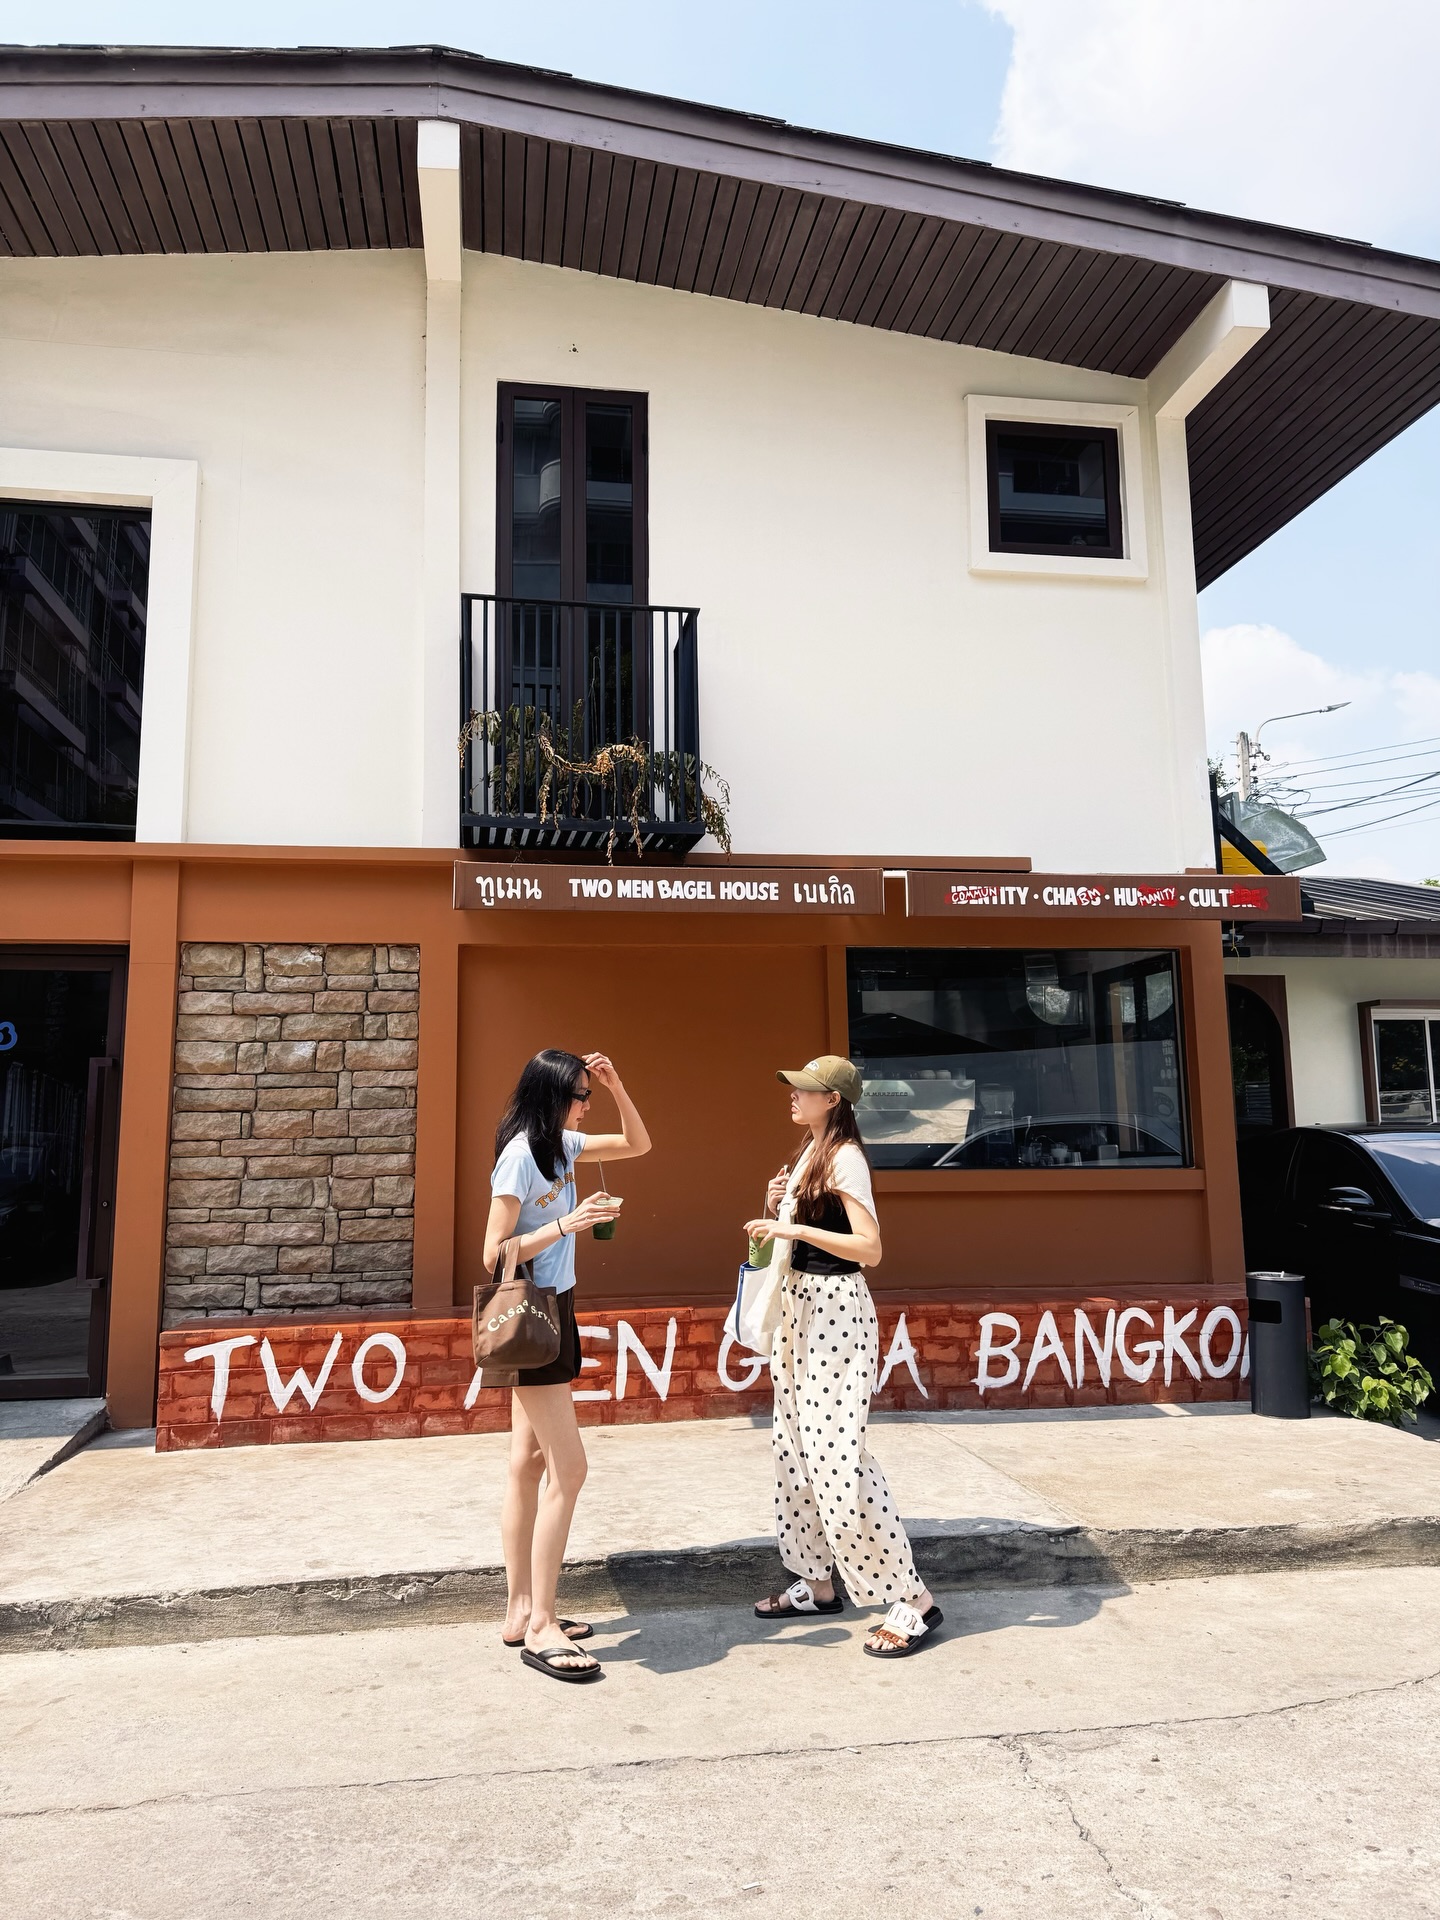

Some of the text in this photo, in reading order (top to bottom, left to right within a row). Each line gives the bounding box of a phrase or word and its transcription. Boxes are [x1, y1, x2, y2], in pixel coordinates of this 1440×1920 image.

[475, 876, 542, 907] ทูเมน
[569, 878, 779, 901] TWO MEN BAGEL HOUSE
[794, 875, 855, 905] เบเกิล
[1189, 888, 1258, 907] CULT
[184, 1330, 407, 1425] TWO
